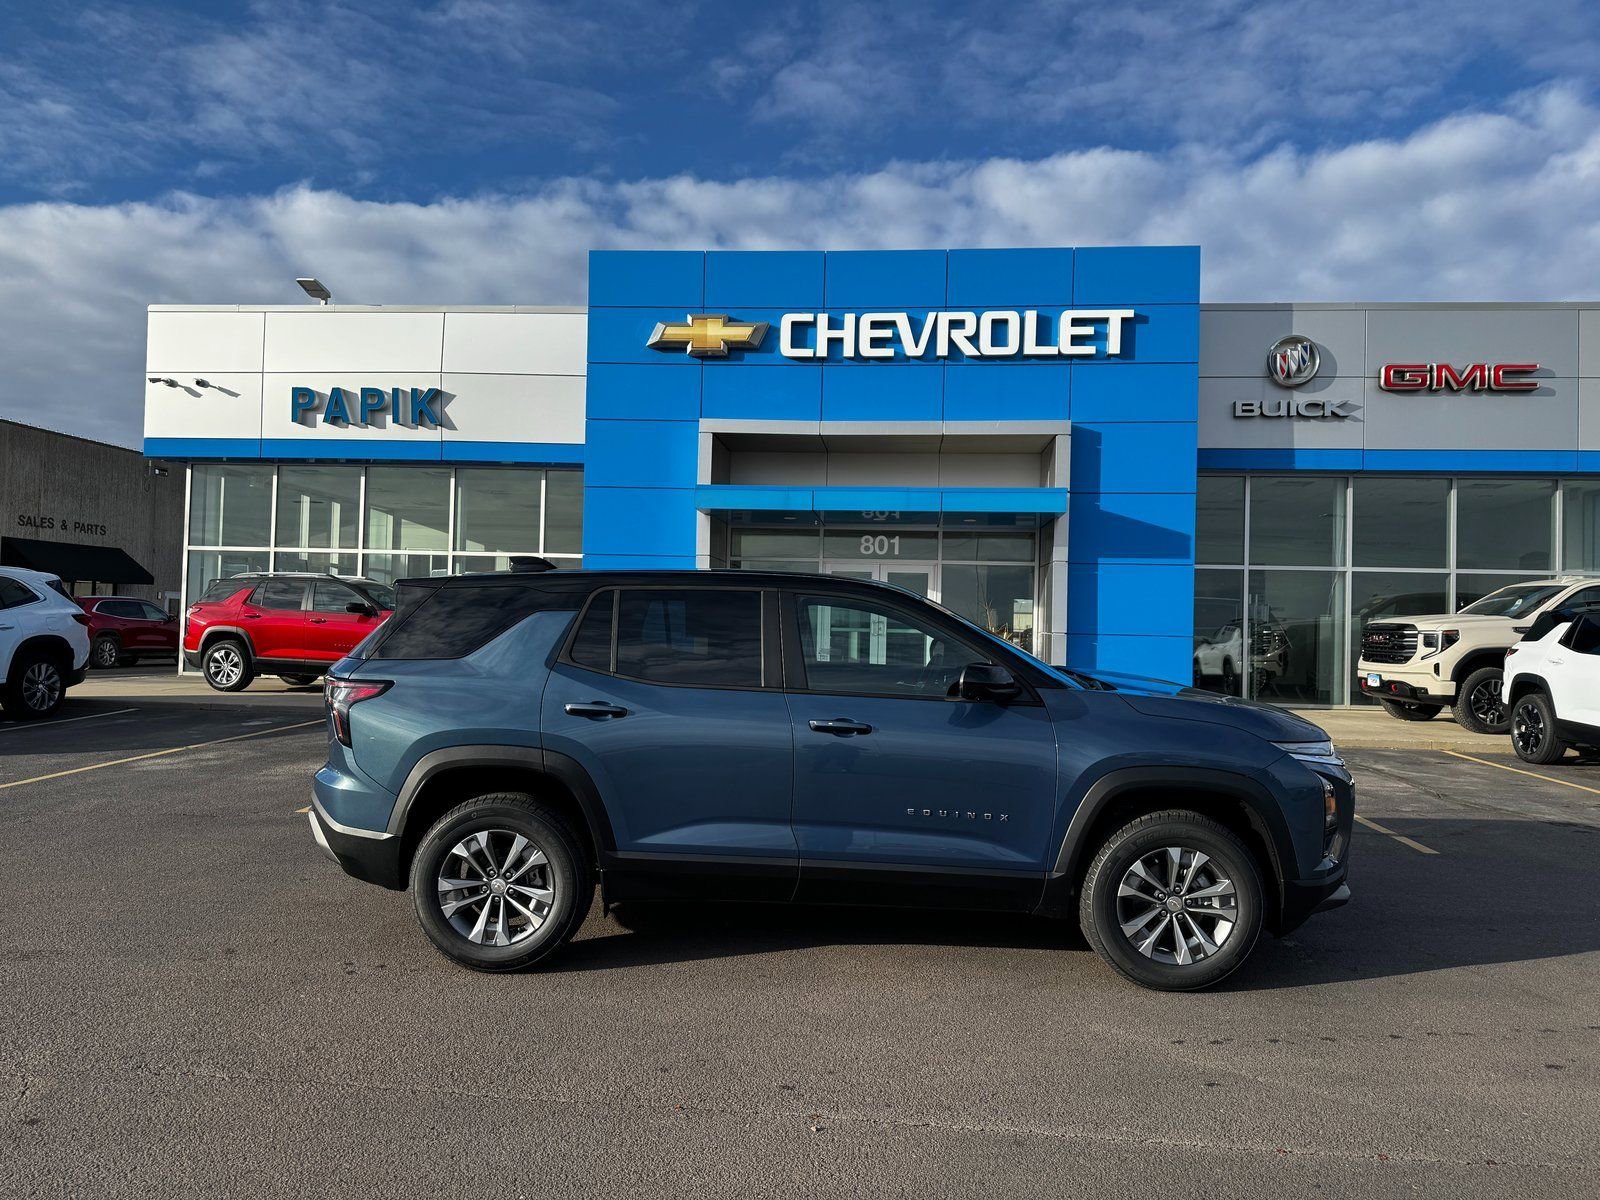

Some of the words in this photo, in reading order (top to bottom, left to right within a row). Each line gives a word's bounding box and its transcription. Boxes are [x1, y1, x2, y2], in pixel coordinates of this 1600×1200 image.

[780, 309, 1134, 358] CHEVROLET
[1379, 363, 1540, 391] GMC
[291, 386, 440, 425] PAPIK
[1233, 399, 1353, 418] BUICK
[17, 514, 55, 529] SALES
[60, 519, 68, 531] &
[74, 521, 107, 536] PARTS
[860, 535, 900, 555] 801
[907, 808, 1009, 822] EQUINOX
